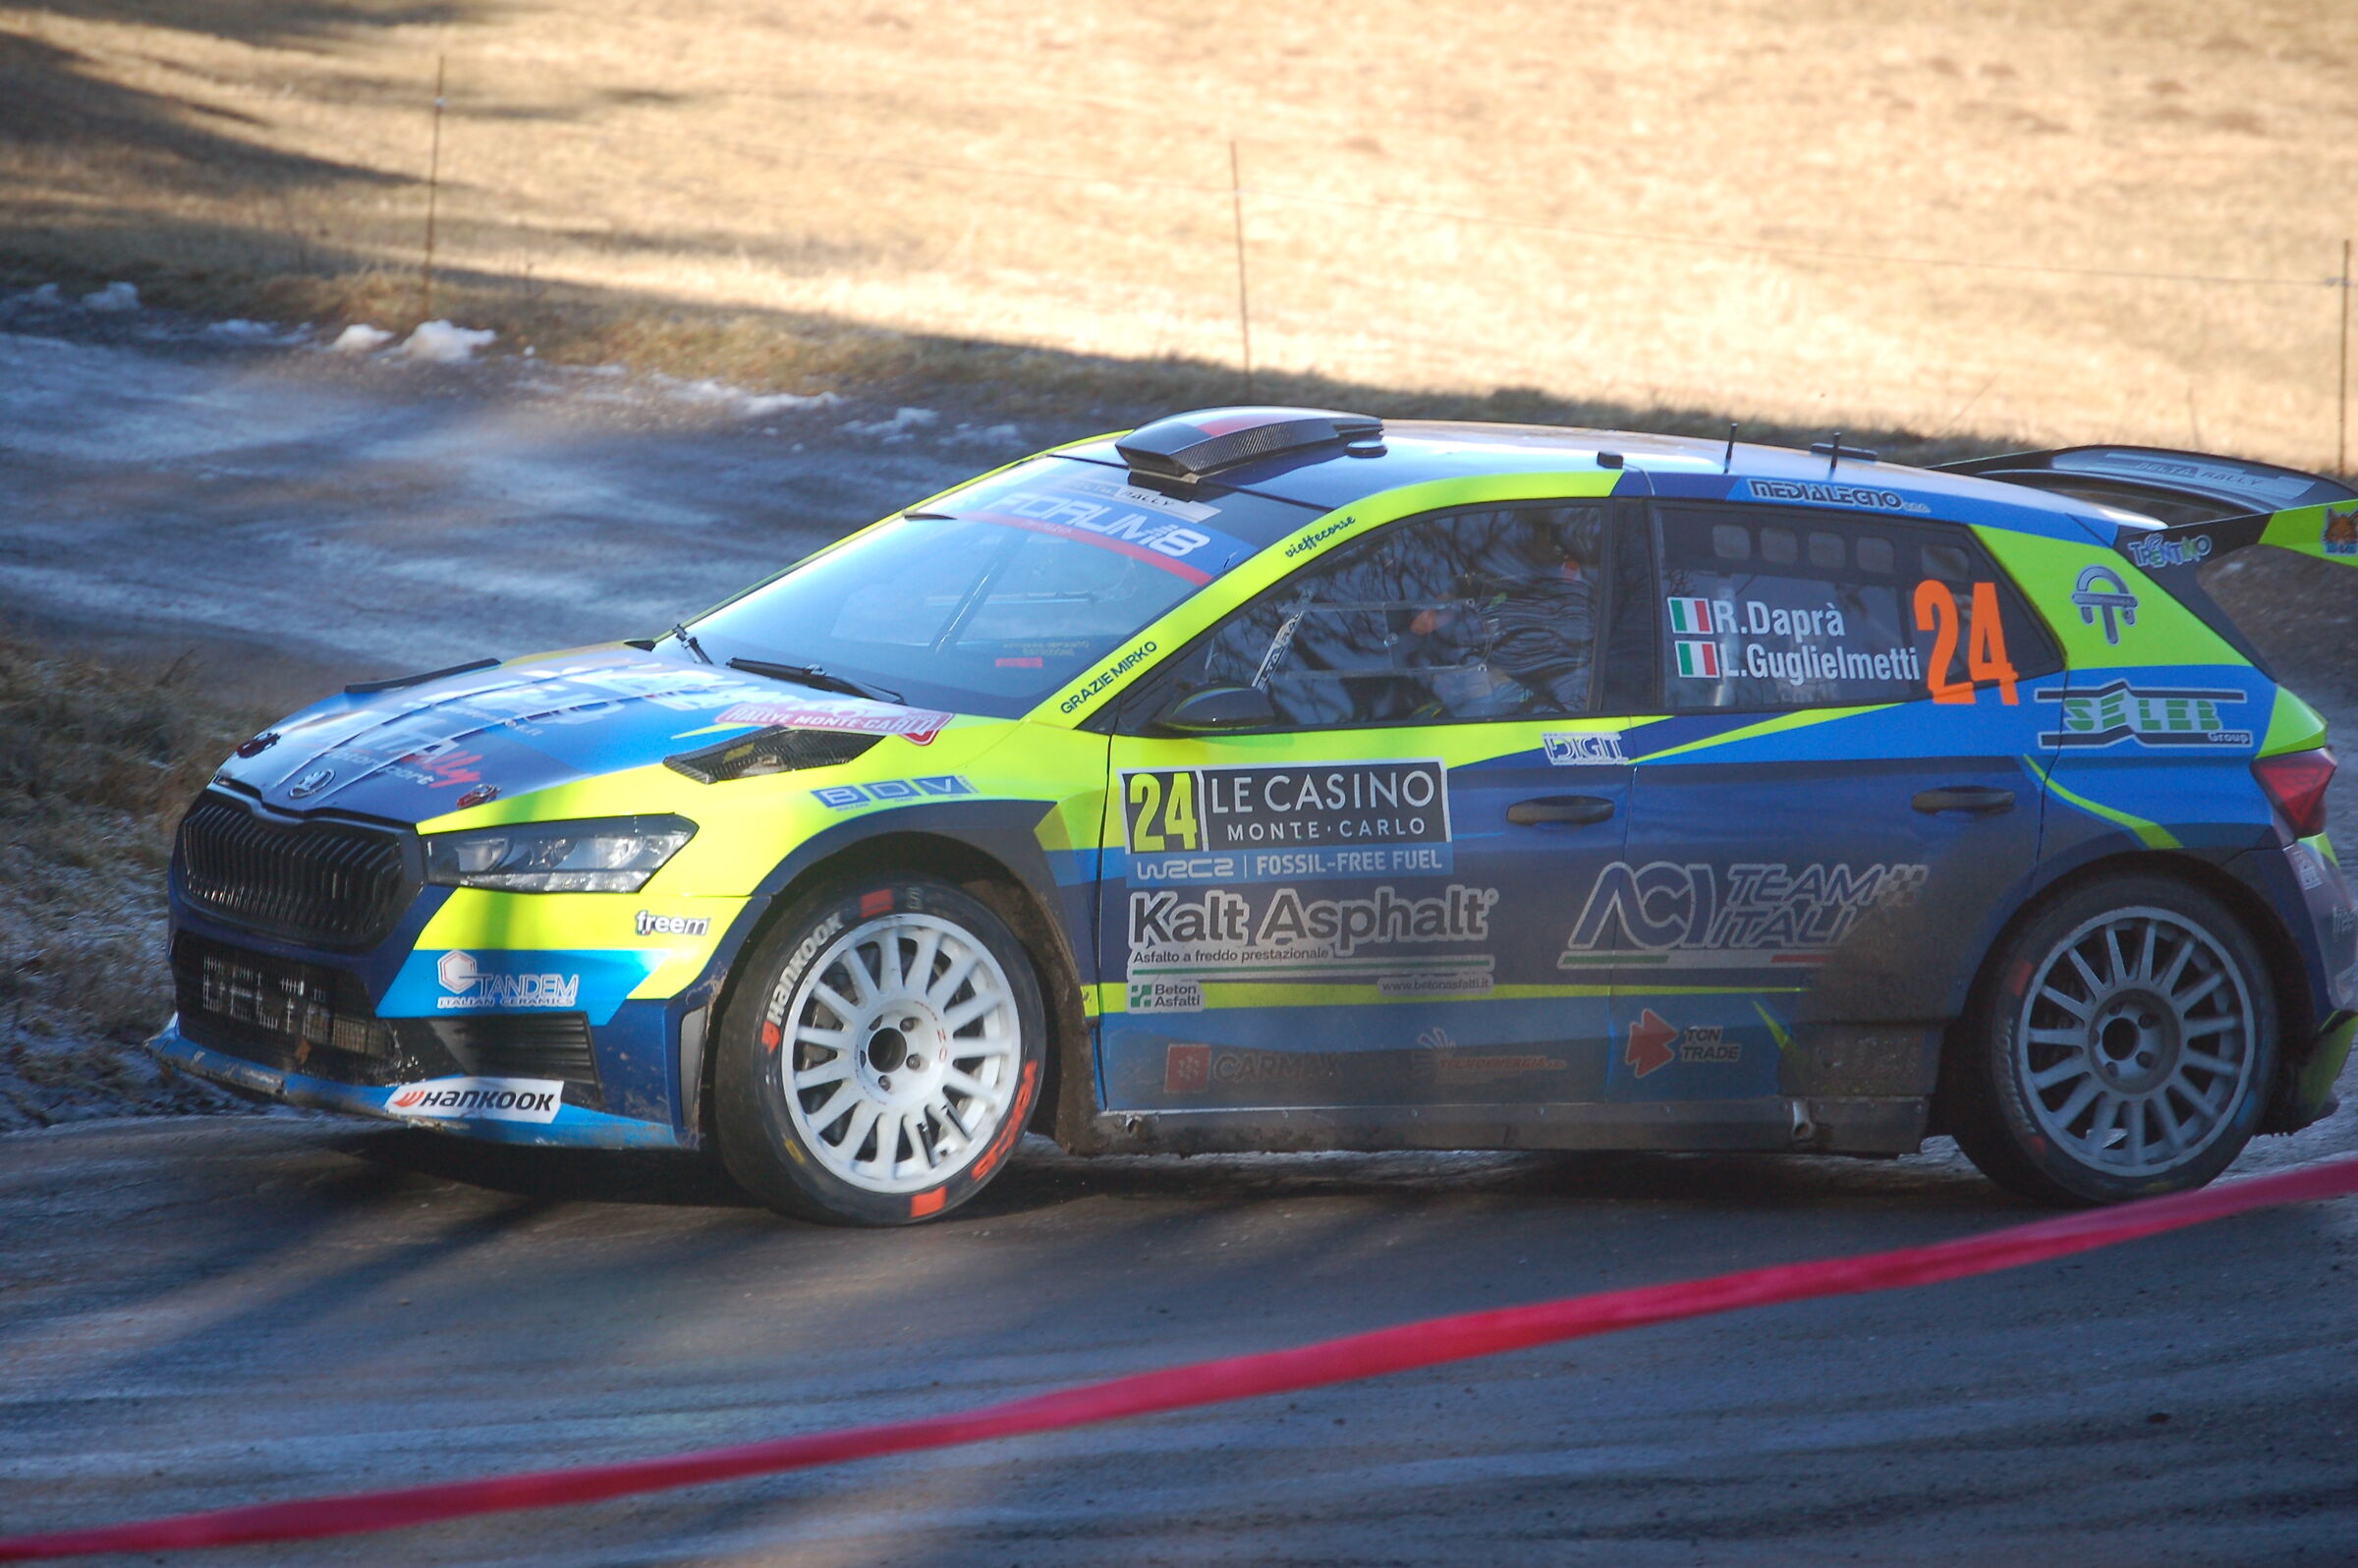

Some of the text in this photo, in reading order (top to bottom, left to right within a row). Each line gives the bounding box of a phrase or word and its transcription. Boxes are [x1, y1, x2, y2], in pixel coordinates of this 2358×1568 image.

[1713, 599, 1845, 643] R.Daprà
[1913, 580, 2020, 705] 24
[1060, 674, 1113, 714] GRAZIE
[1110, 641, 1157, 678] MIRKO
[1720, 643, 1921, 686] L.Guglielmetti
[1130, 771, 1197, 852] 24
[1211, 769, 1434, 813] LE CASINO
[1257, 849, 1386, 876] FOSSIL-FREE
[1392, 849, 1443, 870] FUEL
[637, 911, 708, 933] freem
[1132, 892, 1246, 943] Kalt
[1569, 862, 1886, 949] ACI TEAM
[1707, 905, 1859, 947] ITALI
[1133, 946, 1328, 964] Asfalto a freddo prestazionale
[438, 996, 575, 1007] ITALIAN CERAMICS
[476, 974, 579, 998] TANDEM
[1154, 984, 1197, 995] Beton
[1154, 995, 1201, 1008] Asfalti
[1683, 1045, 1739, 1060] TRADE
